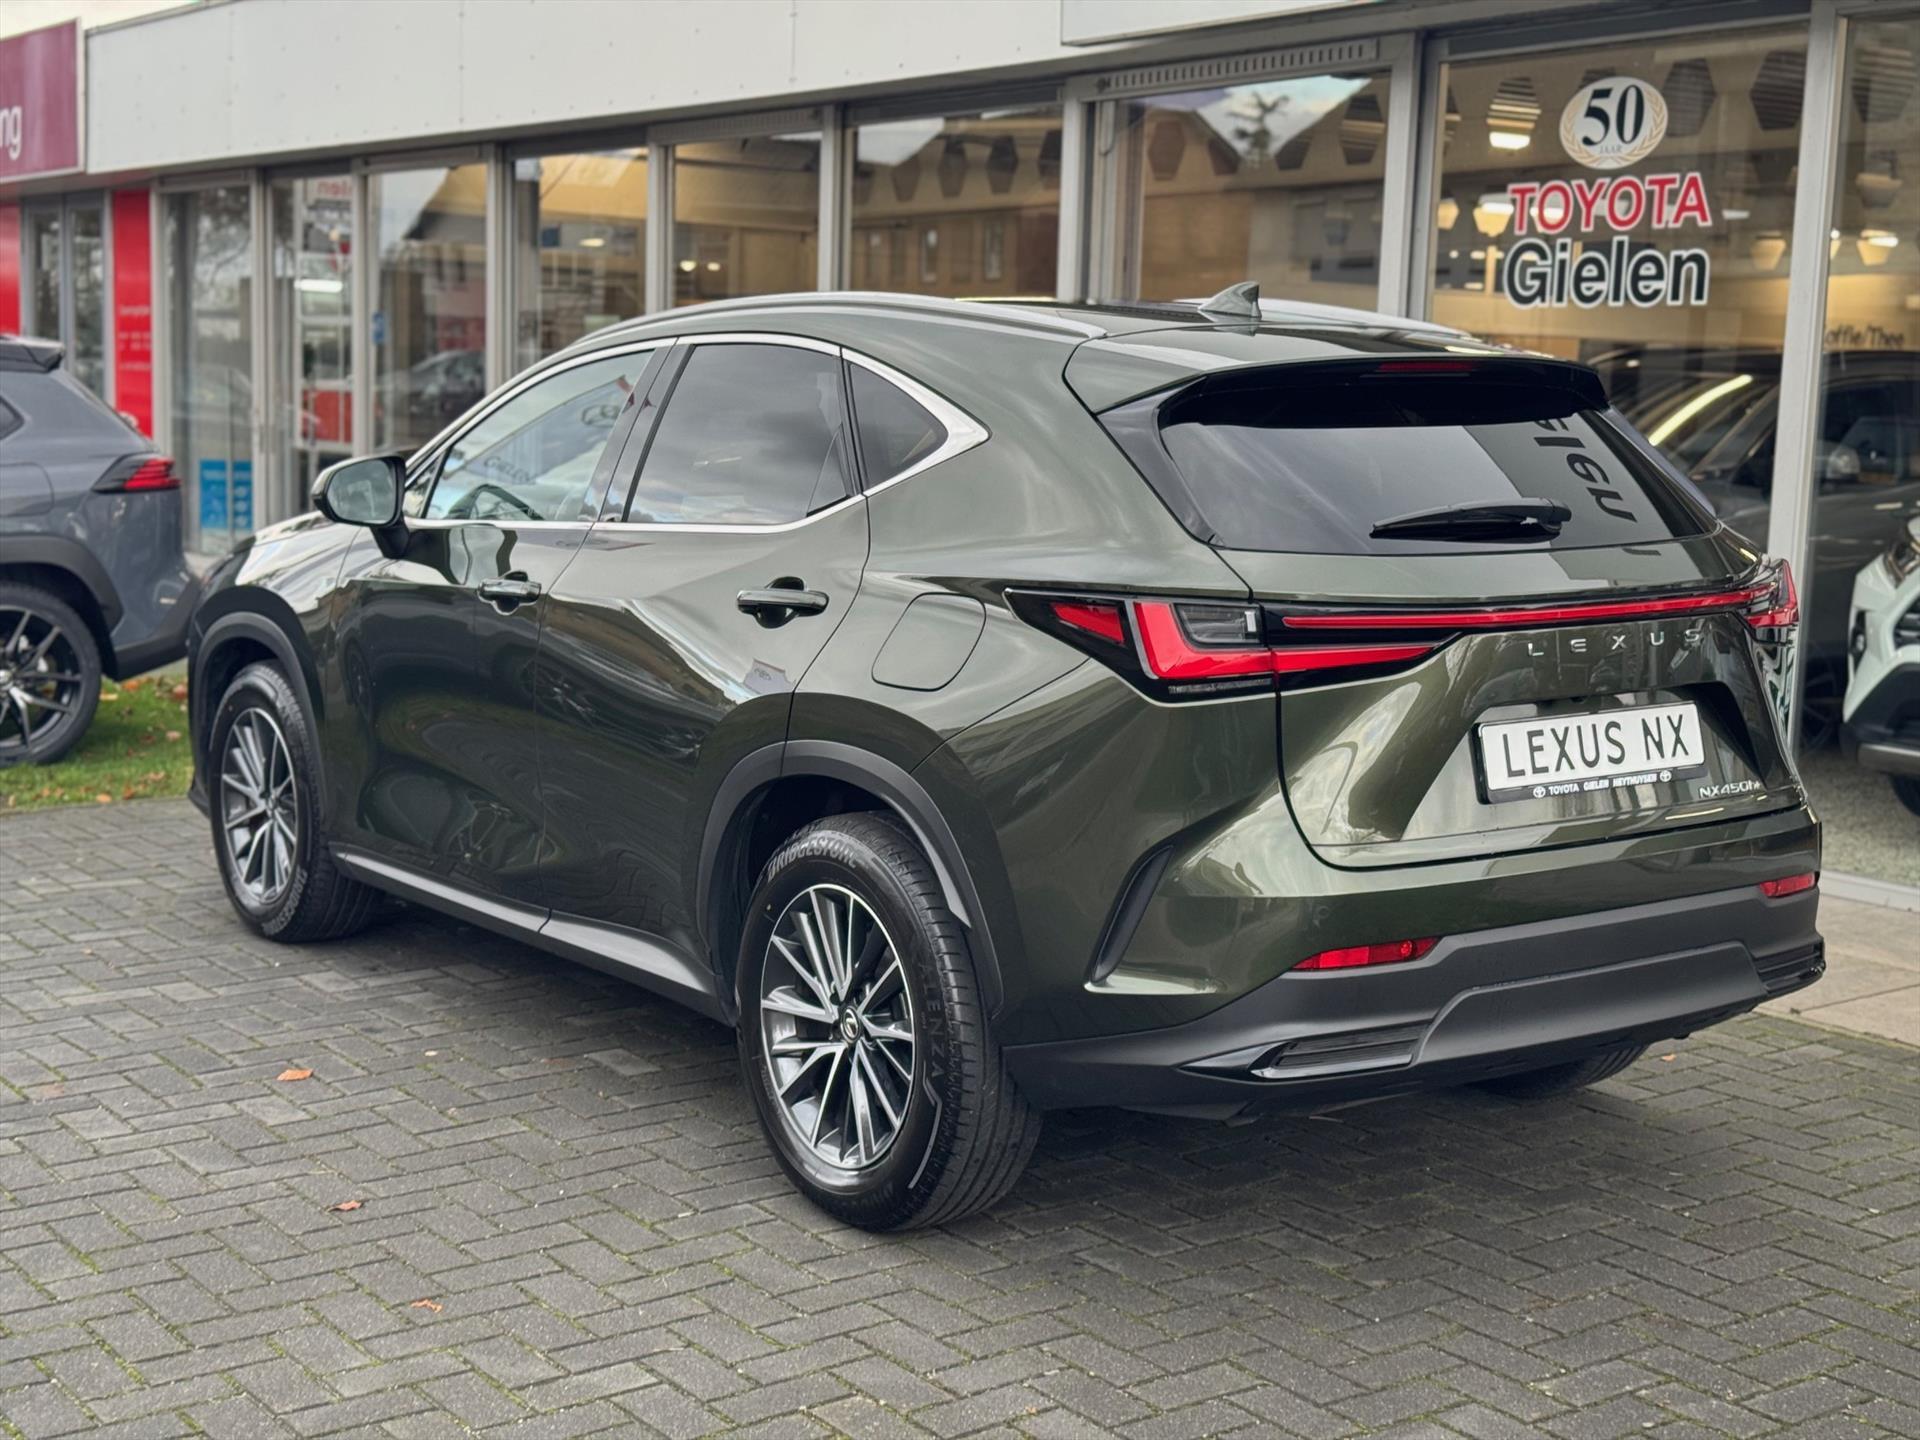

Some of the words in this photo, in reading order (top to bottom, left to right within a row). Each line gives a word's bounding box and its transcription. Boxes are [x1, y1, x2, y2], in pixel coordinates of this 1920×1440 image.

[1581, 84, 1645, 147] 50
[1508, 173, 1711, 234] TOYOTA
[1503, 236, 1710, 308] Gielen
[1527, 627, 1700, 656] LEXUS
[1502, 721, 1626, 778] LEXUS
[1641, 713, 1689, 761] NX
[1548, 782, 1580, 796] TOYOTA
